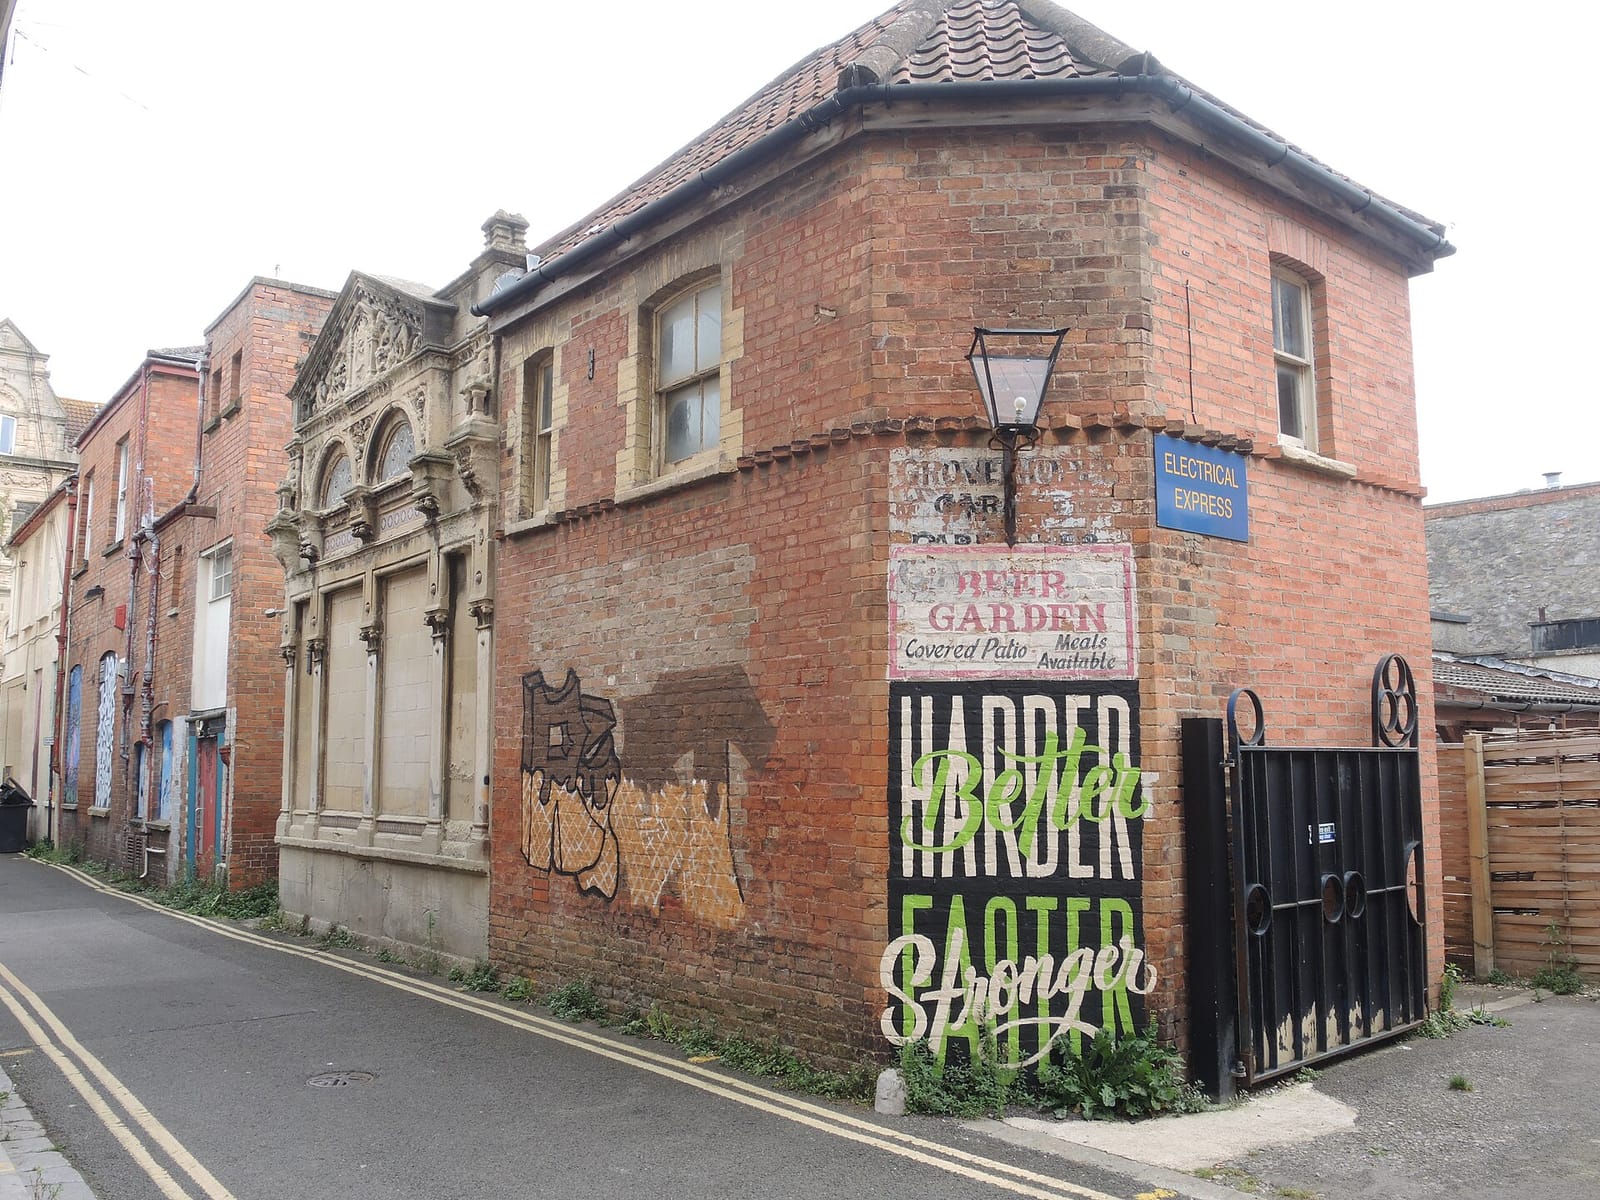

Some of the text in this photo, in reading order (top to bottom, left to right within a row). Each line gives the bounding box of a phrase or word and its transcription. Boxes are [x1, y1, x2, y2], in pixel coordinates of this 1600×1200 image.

[1164, 452, 1239, 488] ELECTRICAL
[1174, 487, 1233, 519] EXPRESS
[957, 569, 1069, 598] BEER
[928, 602, 1107, 632] GARDEN
[905, 637, 1027, 660] Covered Patio
[1055, 634, 1107, 651] Meals
[1037, 652, 1116, 669] Available
[900, 726, 1149, 859] Better
[901, 695, 1135, 879] HARDER
[880, 927, 1157, 1068] Stronger
[902, 895, 1137, 1083] FASTER
